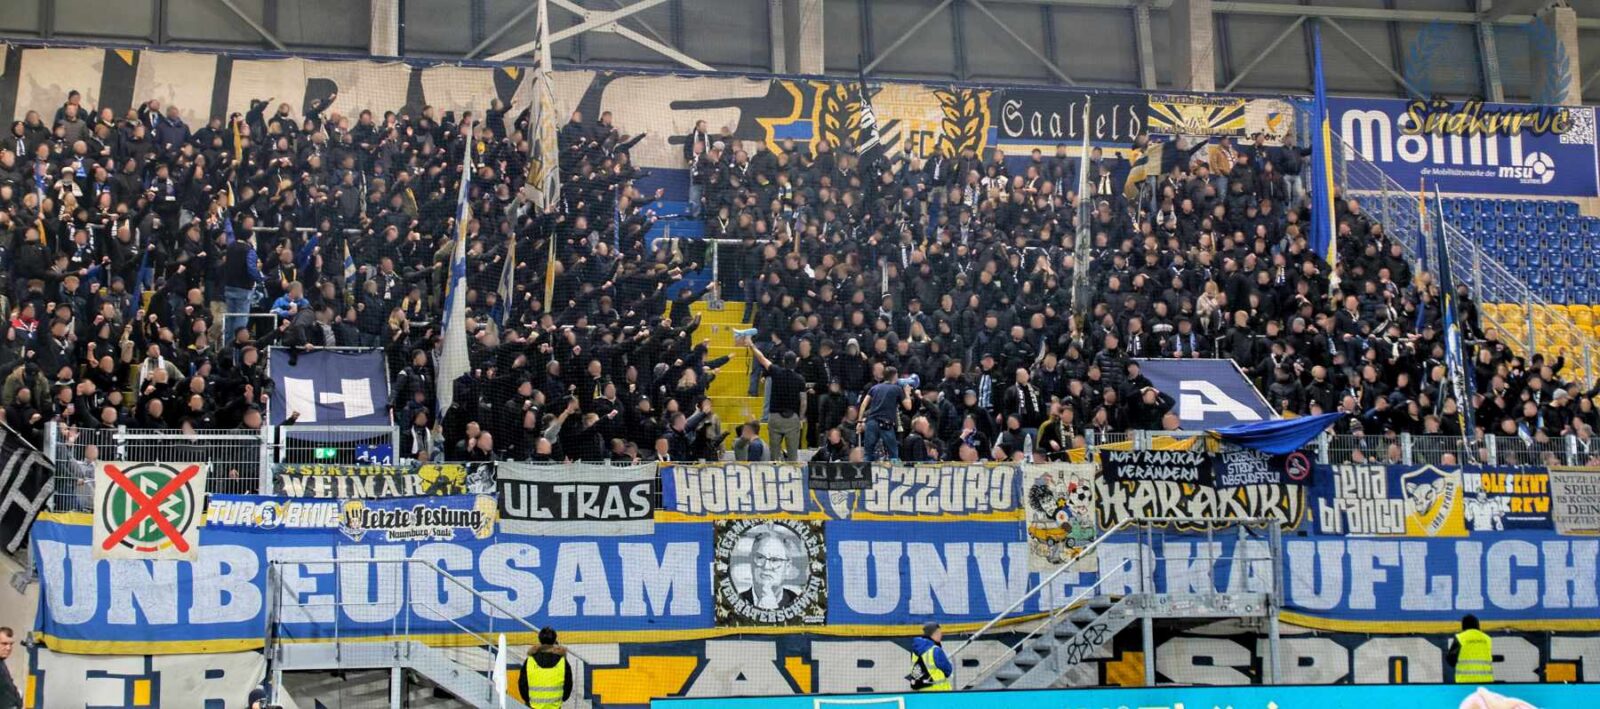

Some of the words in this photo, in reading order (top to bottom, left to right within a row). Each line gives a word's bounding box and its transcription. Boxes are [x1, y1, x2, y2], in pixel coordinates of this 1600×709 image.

[1002, 99, 1141, 140] Saaleld
[1498, 166, 1533, 178] msu
[1180, 380, 1263, 421] A
[1117, 464, 1199, 481] VERÄNDERN
[1144, 451, 1204, 466] RADIKAL
[281, 474, 426, 498] WEIMAR
[504, 483, 651, 519] ULTRAS
[361, 508, 410, 529] Letzte
[414, 506, 481, 530] Festung
[716, 519, 768, 557] HERMA
[772, 519, 819, 557] INKLER
[37, 540, 701, 625] UNBEUGSAM
